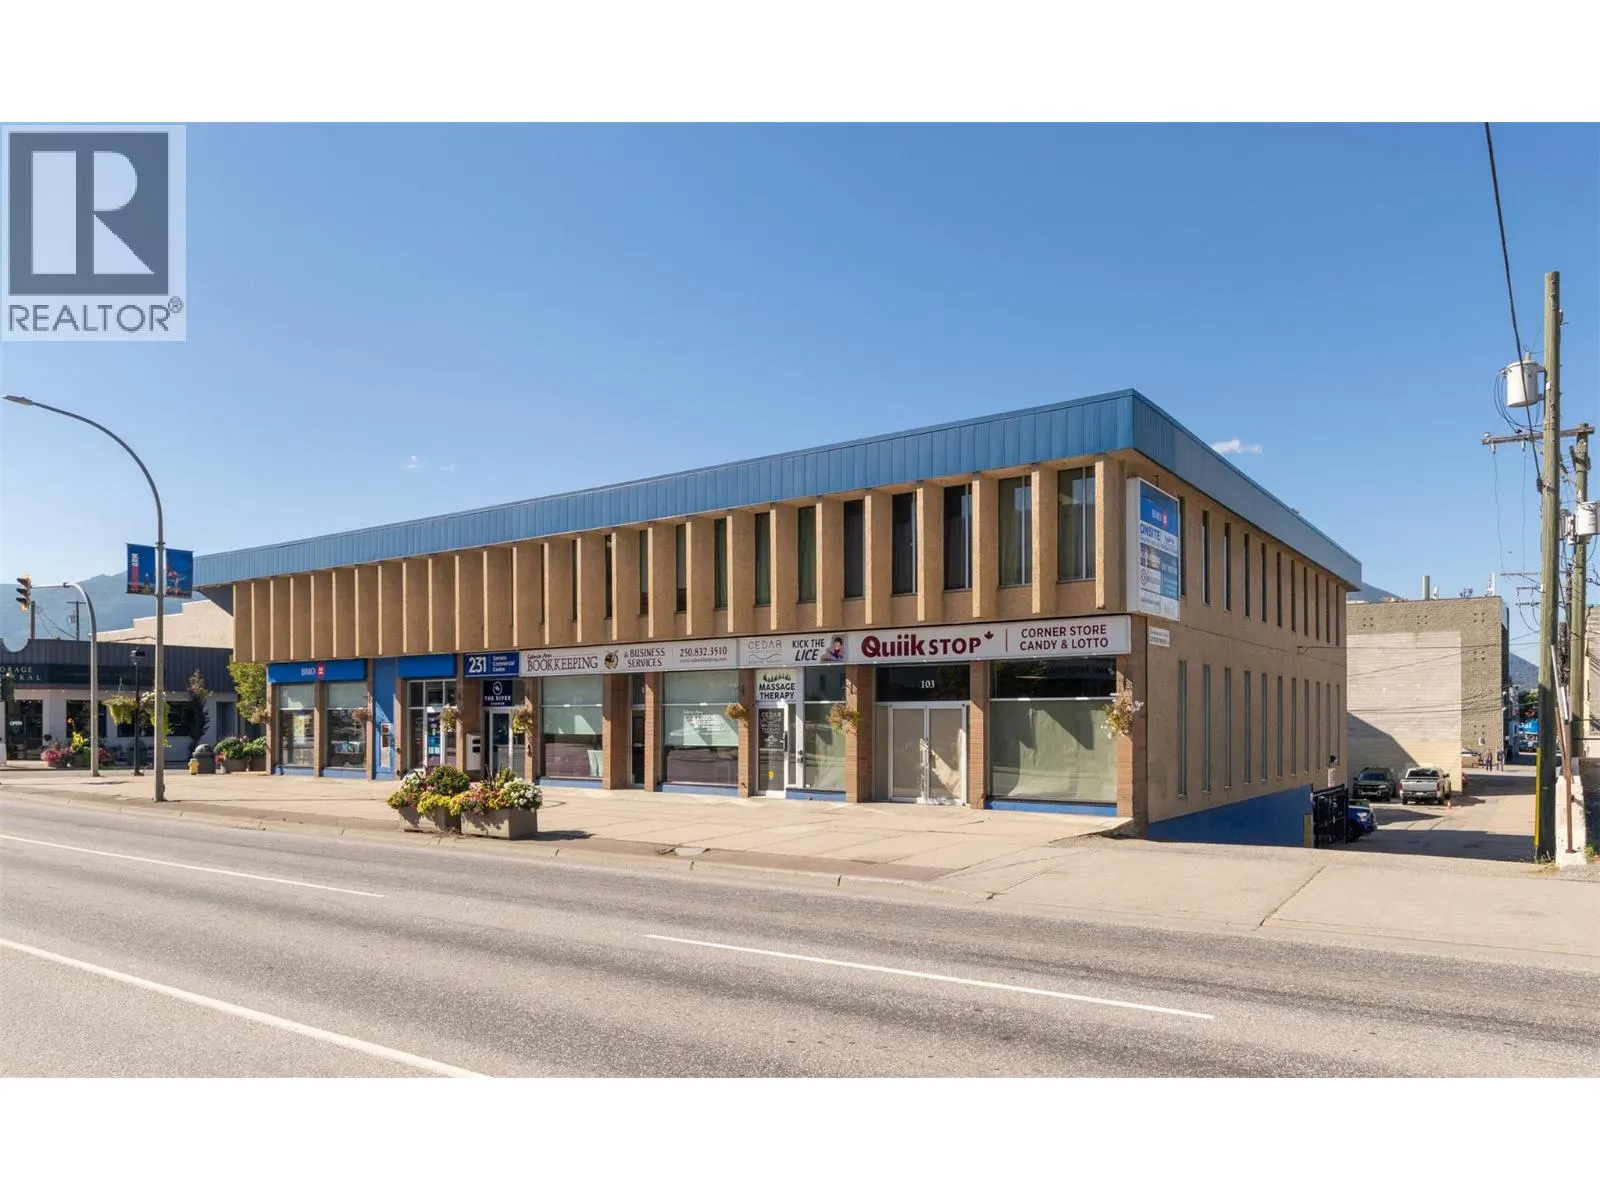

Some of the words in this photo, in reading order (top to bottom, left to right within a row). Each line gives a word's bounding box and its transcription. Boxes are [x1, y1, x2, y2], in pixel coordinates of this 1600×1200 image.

[1140, 523, 1161, 541] ONSITE
[1021, 626, 1067, 639] CORNER
[1069, 624, 1107, 637] STORE
[747, 639, 783, 650] CEDAR
[792, 639, 810, 649] KICK
[811, 638, 825, 648] THE
[861, 633, 925, 658] Quiik
[928, 637, 981, 655] STOP
[1019, 640, 1058, 651] CANDY
[1060, 639, 1068, 650] &
[1071, 637, 1109, 649] LOTTO
[629, 647, 666, 658] BUSINESS
[679, 646, 728, 658] 250.832.3510
[795, 648, 820, 662] LICE
[468, 656, 487, 673] 231
[526, 655, 599, 672] BOOKKEEPING
[627, 657, 663, 668] SERVICES
[301, 667, 316, 676] BMO
[758, 682, 796, 691] MASSAGE
[920, 680, 936, 689] 103
[760, 691, 795, 700] THERAPY
